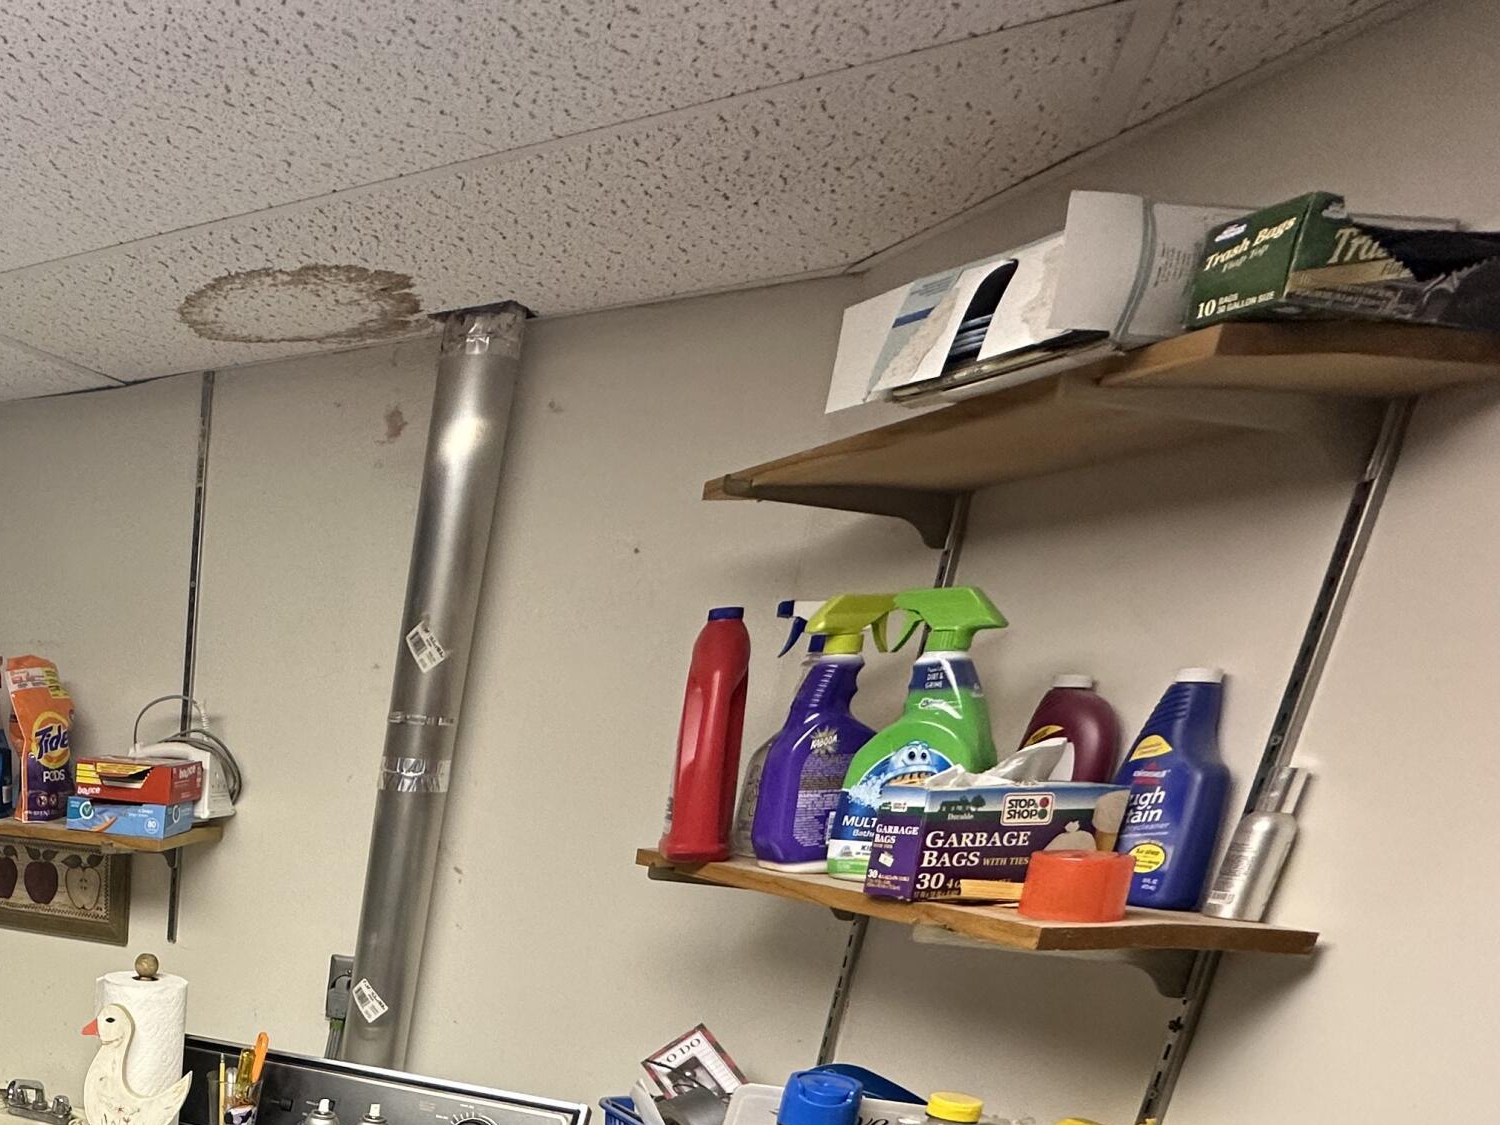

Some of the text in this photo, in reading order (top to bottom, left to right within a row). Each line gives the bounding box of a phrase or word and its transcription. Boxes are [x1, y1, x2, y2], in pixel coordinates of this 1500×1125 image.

[1203, 237, 1251, 272] Trash
[1252, 216, 1298, 247] Bags
[1196, 299, 1217, 320] 10
[34, 724, 69, 761] Tide
[43, 769, 66, 783] PODS
[77, 786, 101, 795] bounce
[1007, 798, 1034, 809] STOP
[1006, 809, 1038, 820] SHOP
[842, 815, 878, 828] MULT
[852, 829, 875, 838] Bath
[876, 823, 920, 836] GARBAGE
[874, 834, 897, 844] BAGS
[925, 830, 1031, 848] GARBAGE
[920, 851, 1030, 868] BAGS WITH TIES
[867, 868, 879, 879] 30
[915, 872, 946, 890] 30
[680, 1036, 702, 1056] DO
